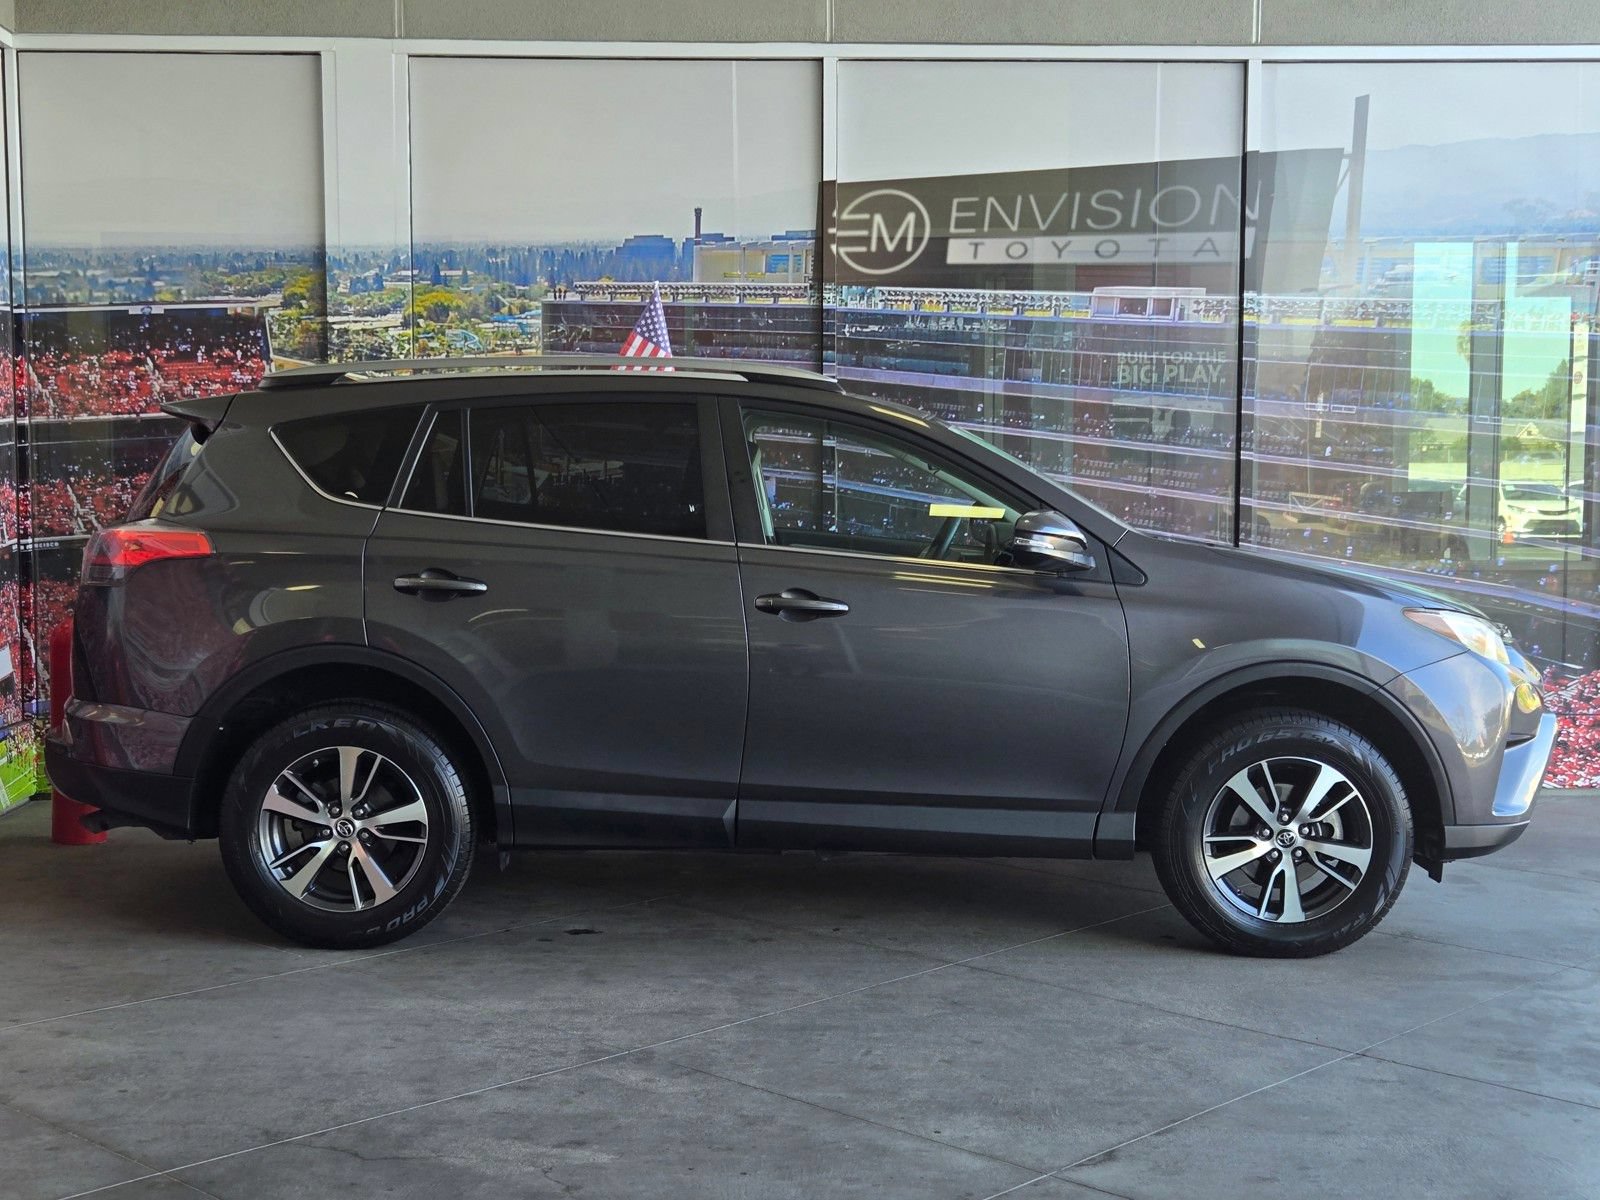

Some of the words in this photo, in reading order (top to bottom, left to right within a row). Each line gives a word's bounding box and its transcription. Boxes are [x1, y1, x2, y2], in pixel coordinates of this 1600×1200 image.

[949, 180, 1262, 233] ENVISION
[967, 237, 1220, 260] TOYOTA
[1117, 351, 1160, 364] BUILT
[1162, 351, 1194, 364] FOR
[1196, 351, 1227, 364] THE
[1117, 364, 1158, 384] BIG
[1163, 364, 1226, 384] PLAY.
